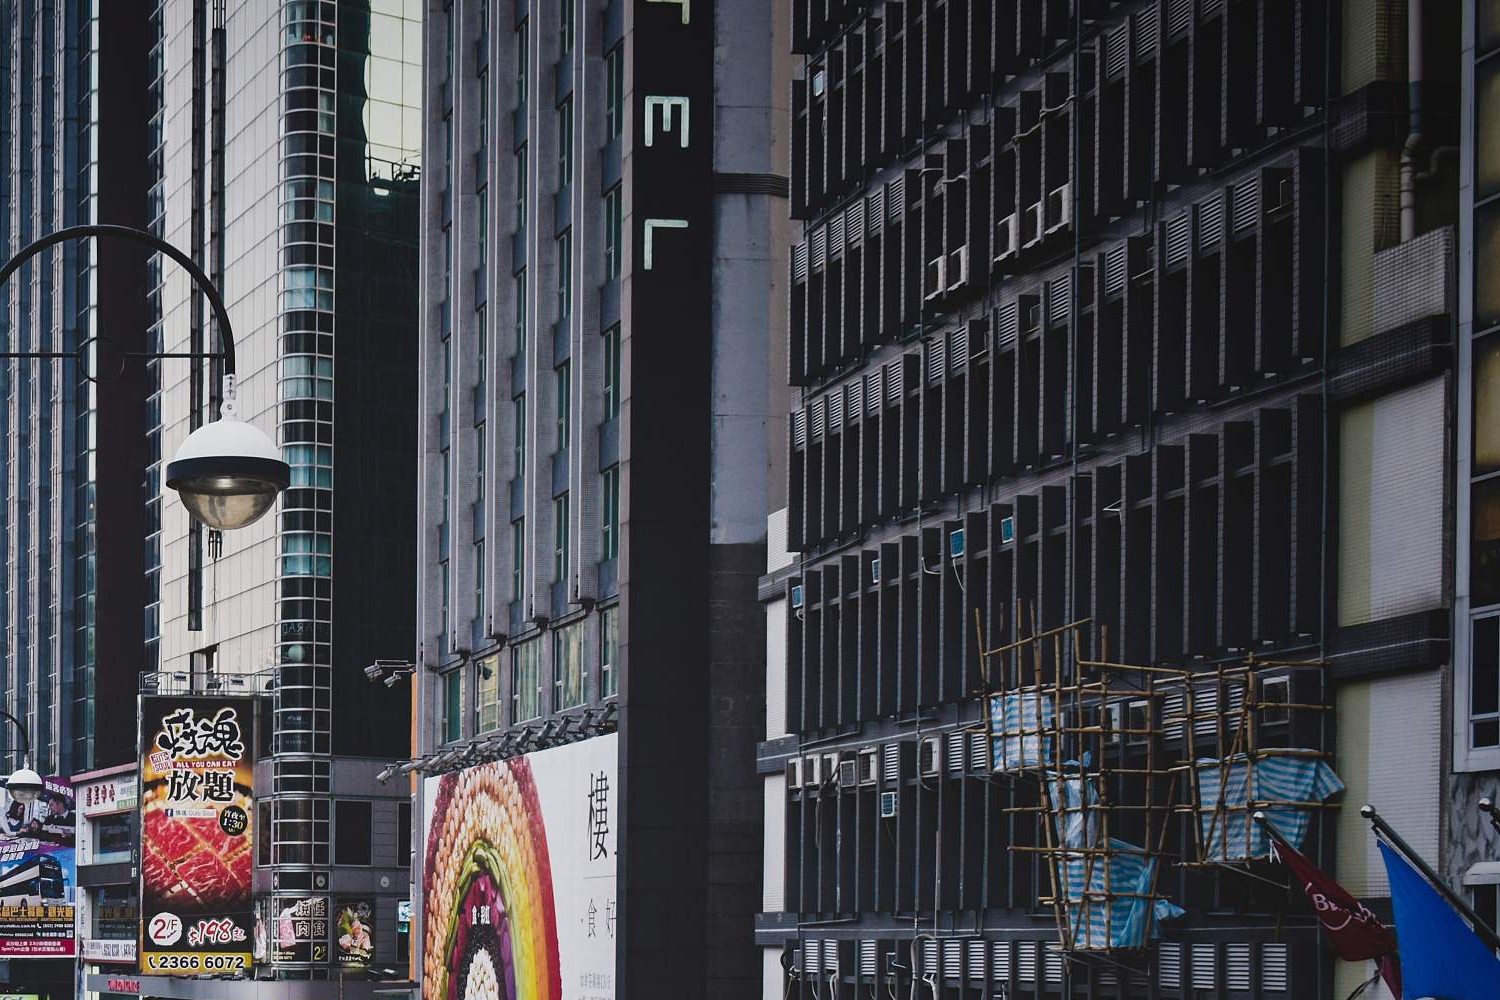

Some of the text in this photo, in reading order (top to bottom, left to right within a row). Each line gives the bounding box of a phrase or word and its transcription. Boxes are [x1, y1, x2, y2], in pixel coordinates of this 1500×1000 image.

[168, 770, 234, 801] 放題
[222, 818, 244, 830] 1:30
[153, 919, 178, 939] 2/F
[160, 956, 244, 968] 2366 6072
